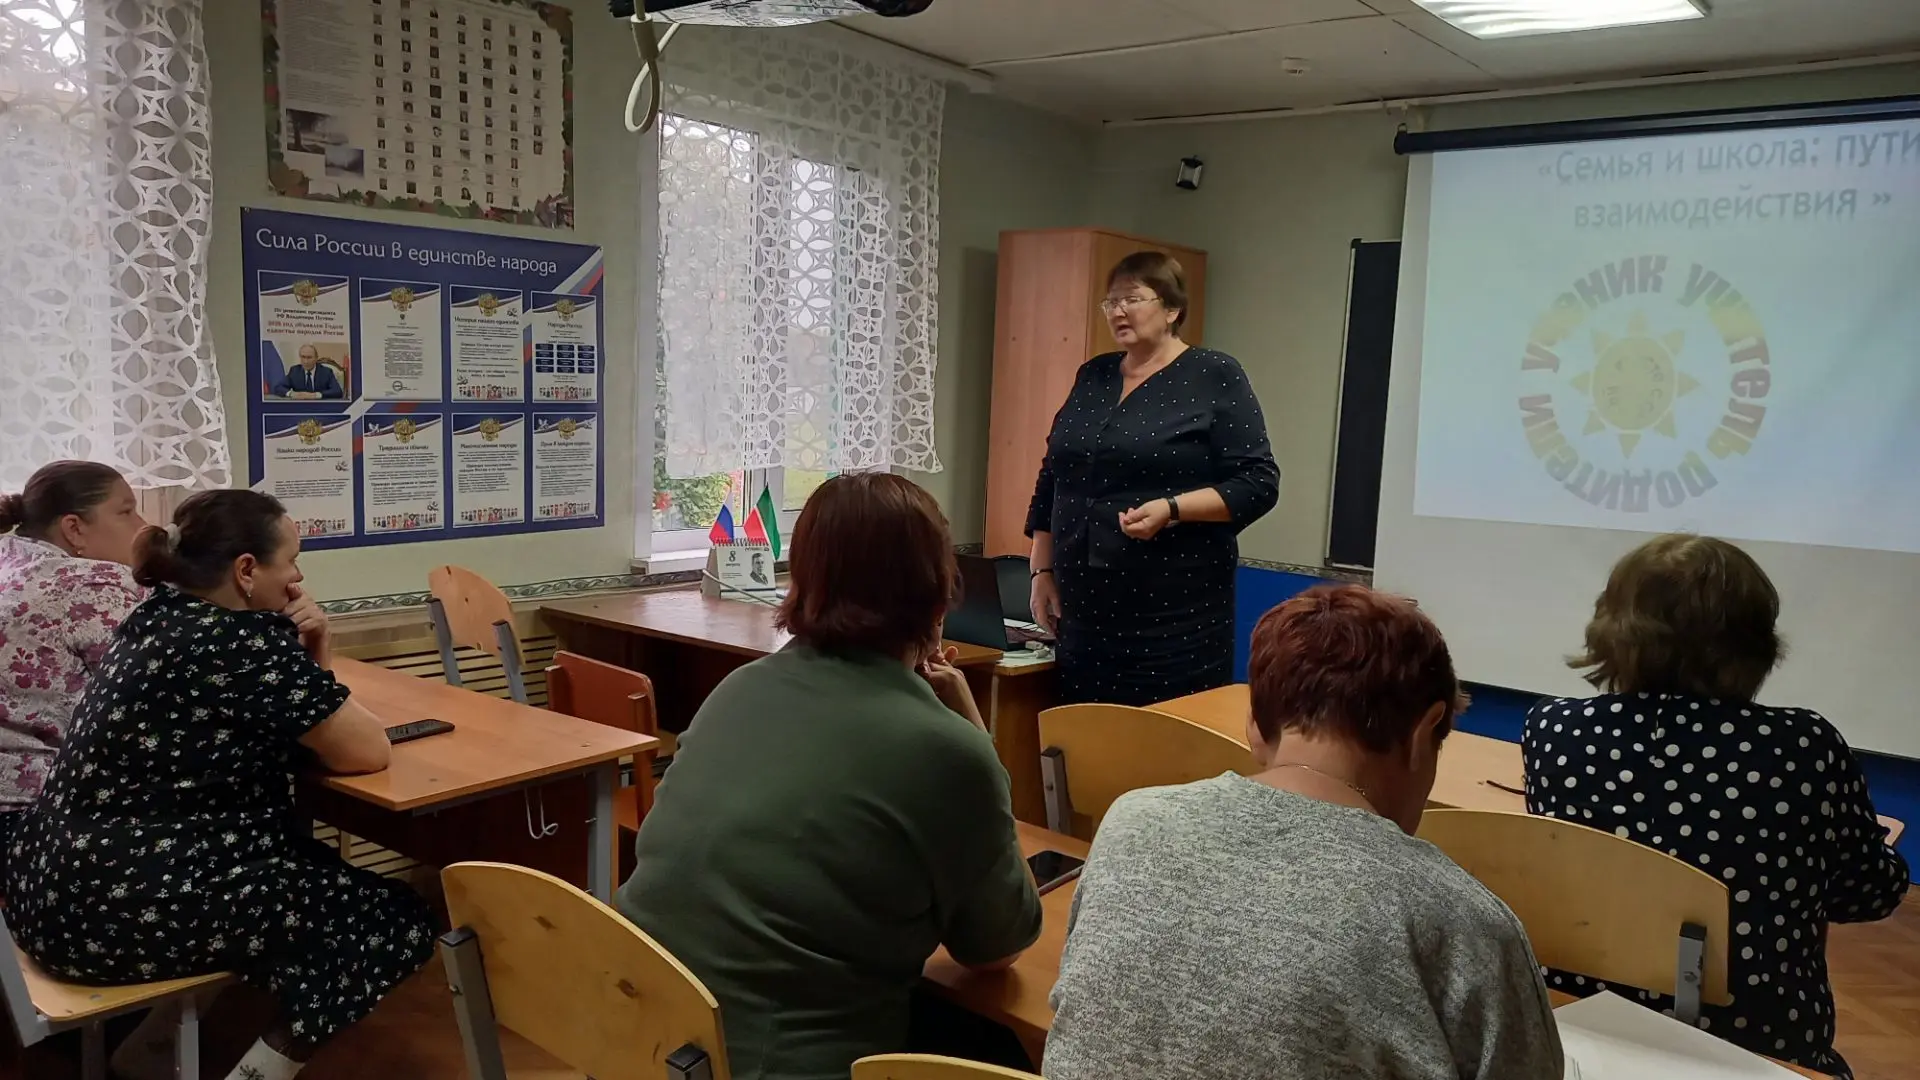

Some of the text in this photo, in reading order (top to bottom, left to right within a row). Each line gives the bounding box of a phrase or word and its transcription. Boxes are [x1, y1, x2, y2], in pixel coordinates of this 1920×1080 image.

[1538, 128, 1920, 185] «Семья и школа: пути
[1574, 183, 1858, 231] взаимодействия
[255, 227, 308, 251] Сила
[315, 233, 385, 258] России
[408, 247, 497, 269] единстве
[501, 255, 558, 276] народа
[729, 550, 736, 562] 8
